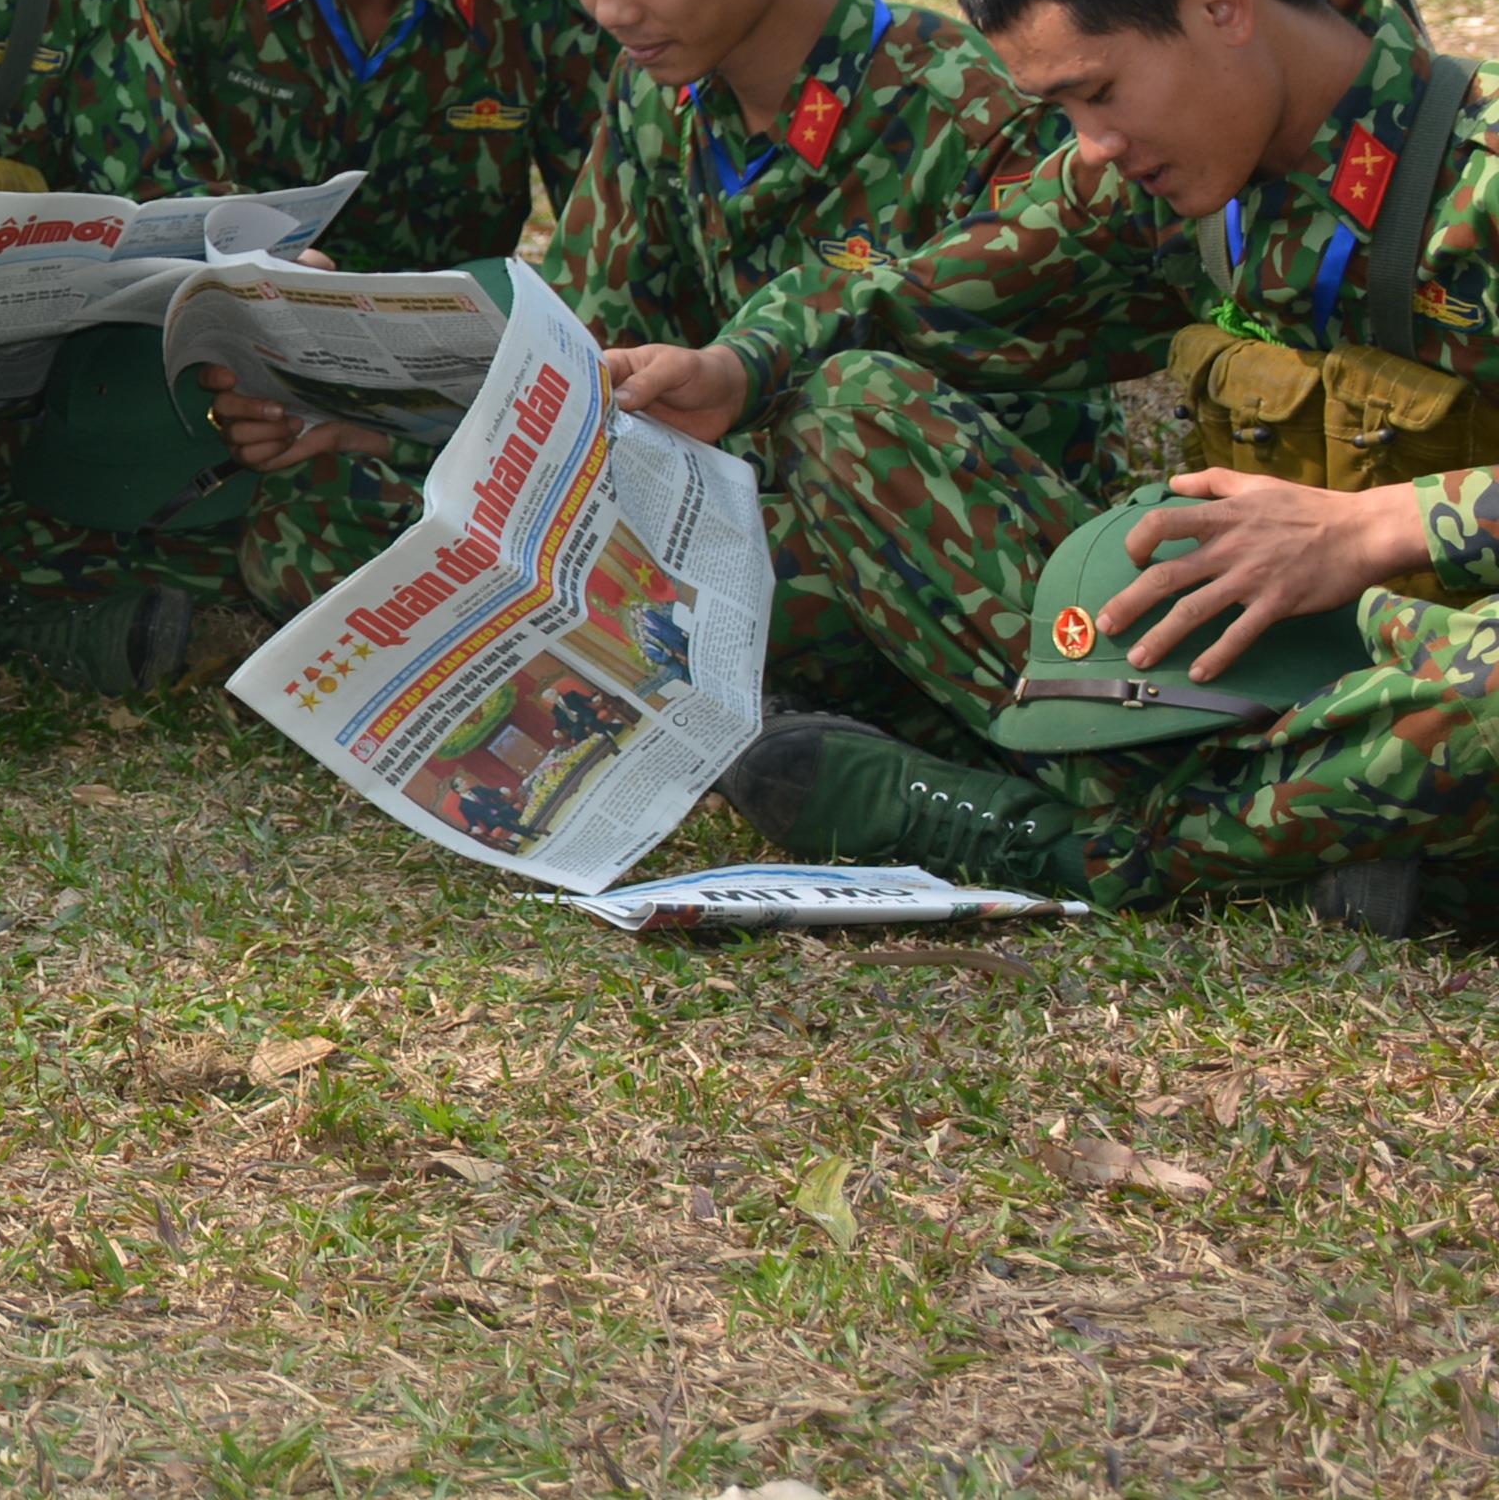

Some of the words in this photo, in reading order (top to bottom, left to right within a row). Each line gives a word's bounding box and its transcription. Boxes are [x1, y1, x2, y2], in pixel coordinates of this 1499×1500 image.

[344, 566, 457, 648] Quân
[434, 523, 500, 587] đội
[471, 432, 540, 539] nhân
[513, 361, 573, 446] dân
[372, 706, 403, 738] HỌC
[396, 685, 426, 714] TẬP
[420, 669, 442, 691] VÀ
[434, 648, 467, 677] LÀM
[461, 624, 496, 655] THEO
[559, 474, 591, 523] PHONG
[582, 532, 599, 551] Nam
